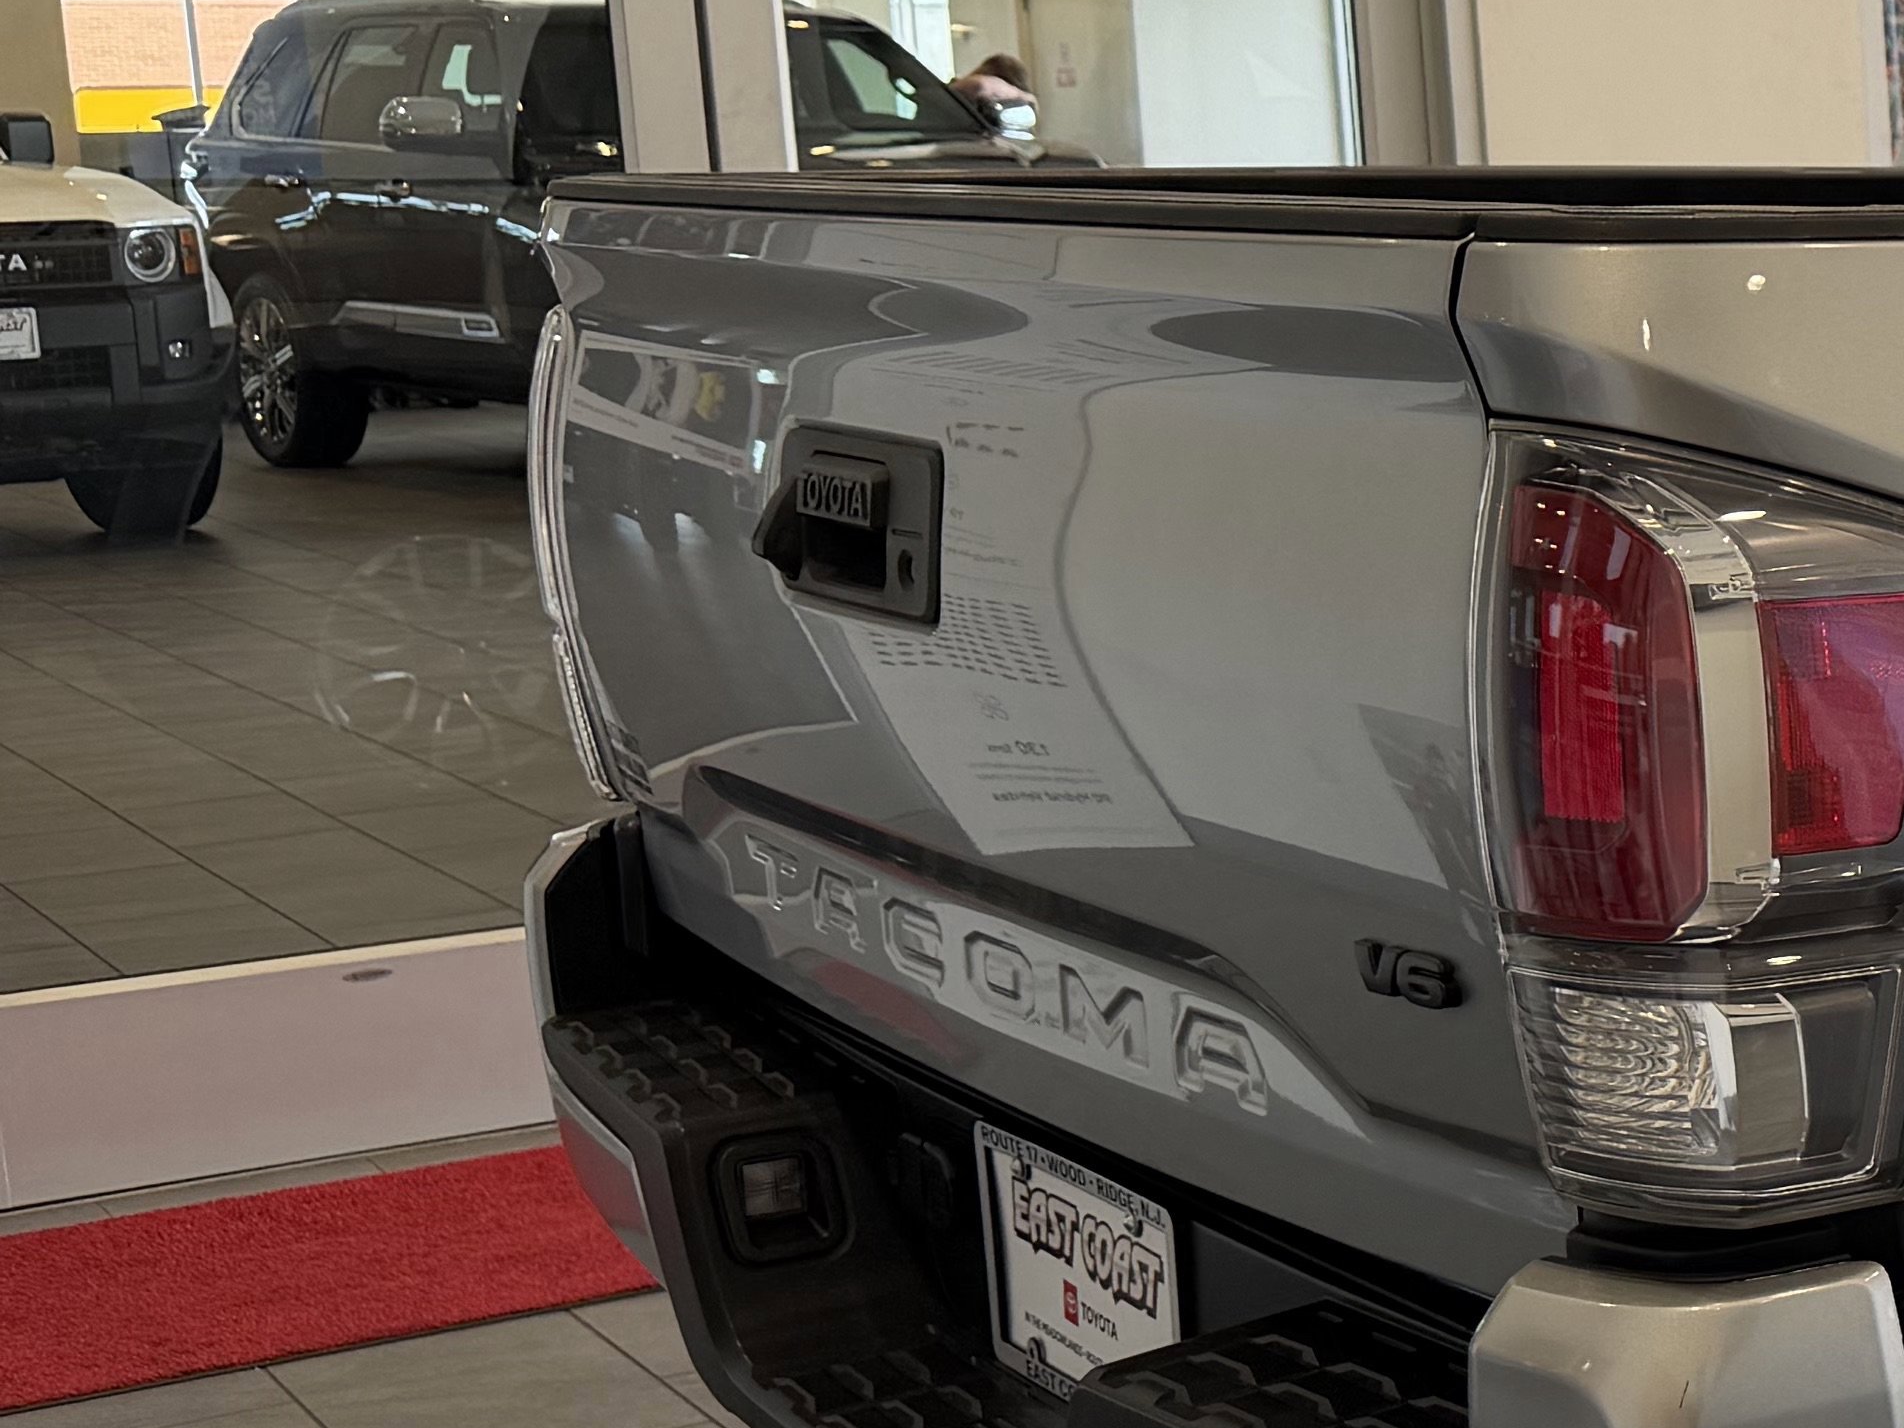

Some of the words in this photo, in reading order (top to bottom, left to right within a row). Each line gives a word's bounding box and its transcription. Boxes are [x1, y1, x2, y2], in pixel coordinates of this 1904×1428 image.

[800, 473, 863, 518] TOYOTA
[744, 834, 1270, 1116] TACOMA
[1354, 937, 1461, 1009] V6
[981, 1126, 1024, 1158] ROUTE
[1025, 1146, 1038, 1163] 17
[1048, 1156, 1086, 1186] WOOD
[1141, 1201, 1166, 1228] N.J.
[1012, 1176, 1080, 1267] EAST
[1081, 1213, 1164, 1319] COAST
[1081, 1302, 1118, 1341] TOYOTA
[1026, 1359, 1056, 1392] EAST
